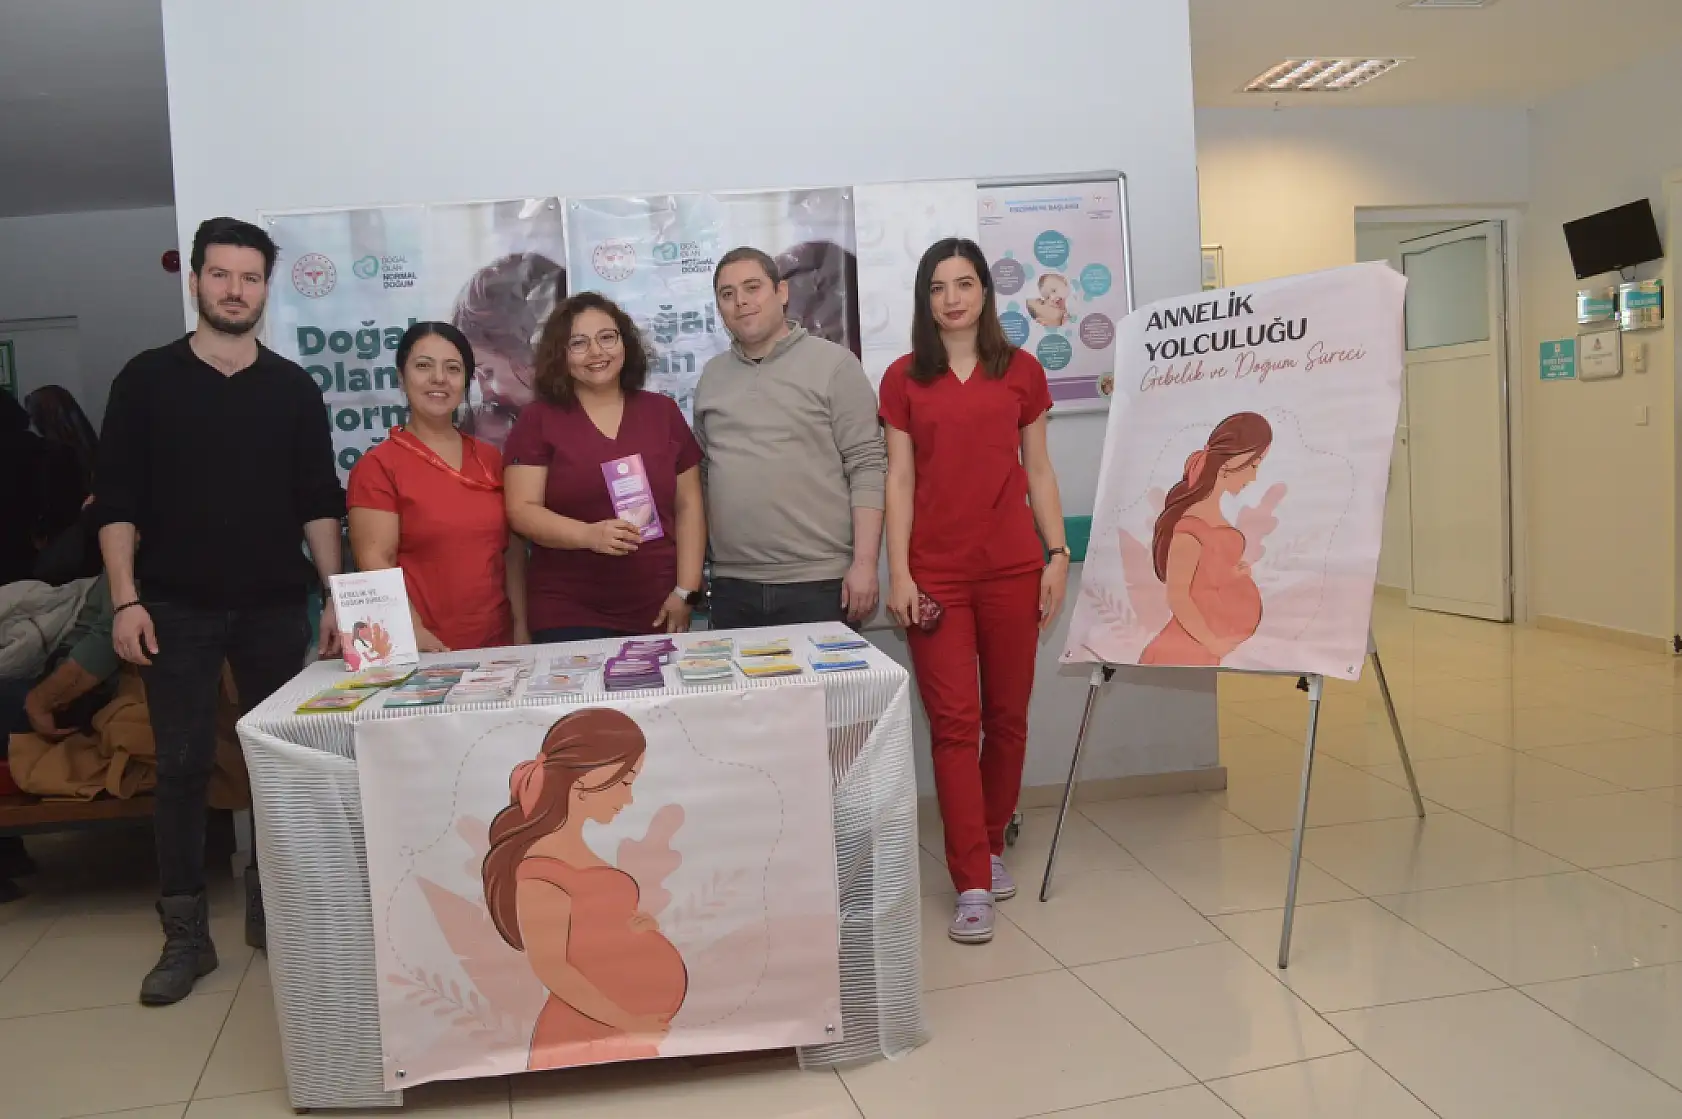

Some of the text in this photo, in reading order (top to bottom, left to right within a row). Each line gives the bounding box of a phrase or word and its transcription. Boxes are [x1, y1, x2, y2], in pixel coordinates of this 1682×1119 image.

[1145, 290, 1254, 331] ANNELİK
[297, 318, 416, 359] Doğa
[1145, 316, 1307, 361] YOLCULUĞU
[1140, 360, 1205, 392] Gebelik
[1210, 366, 1228, 378] ve
